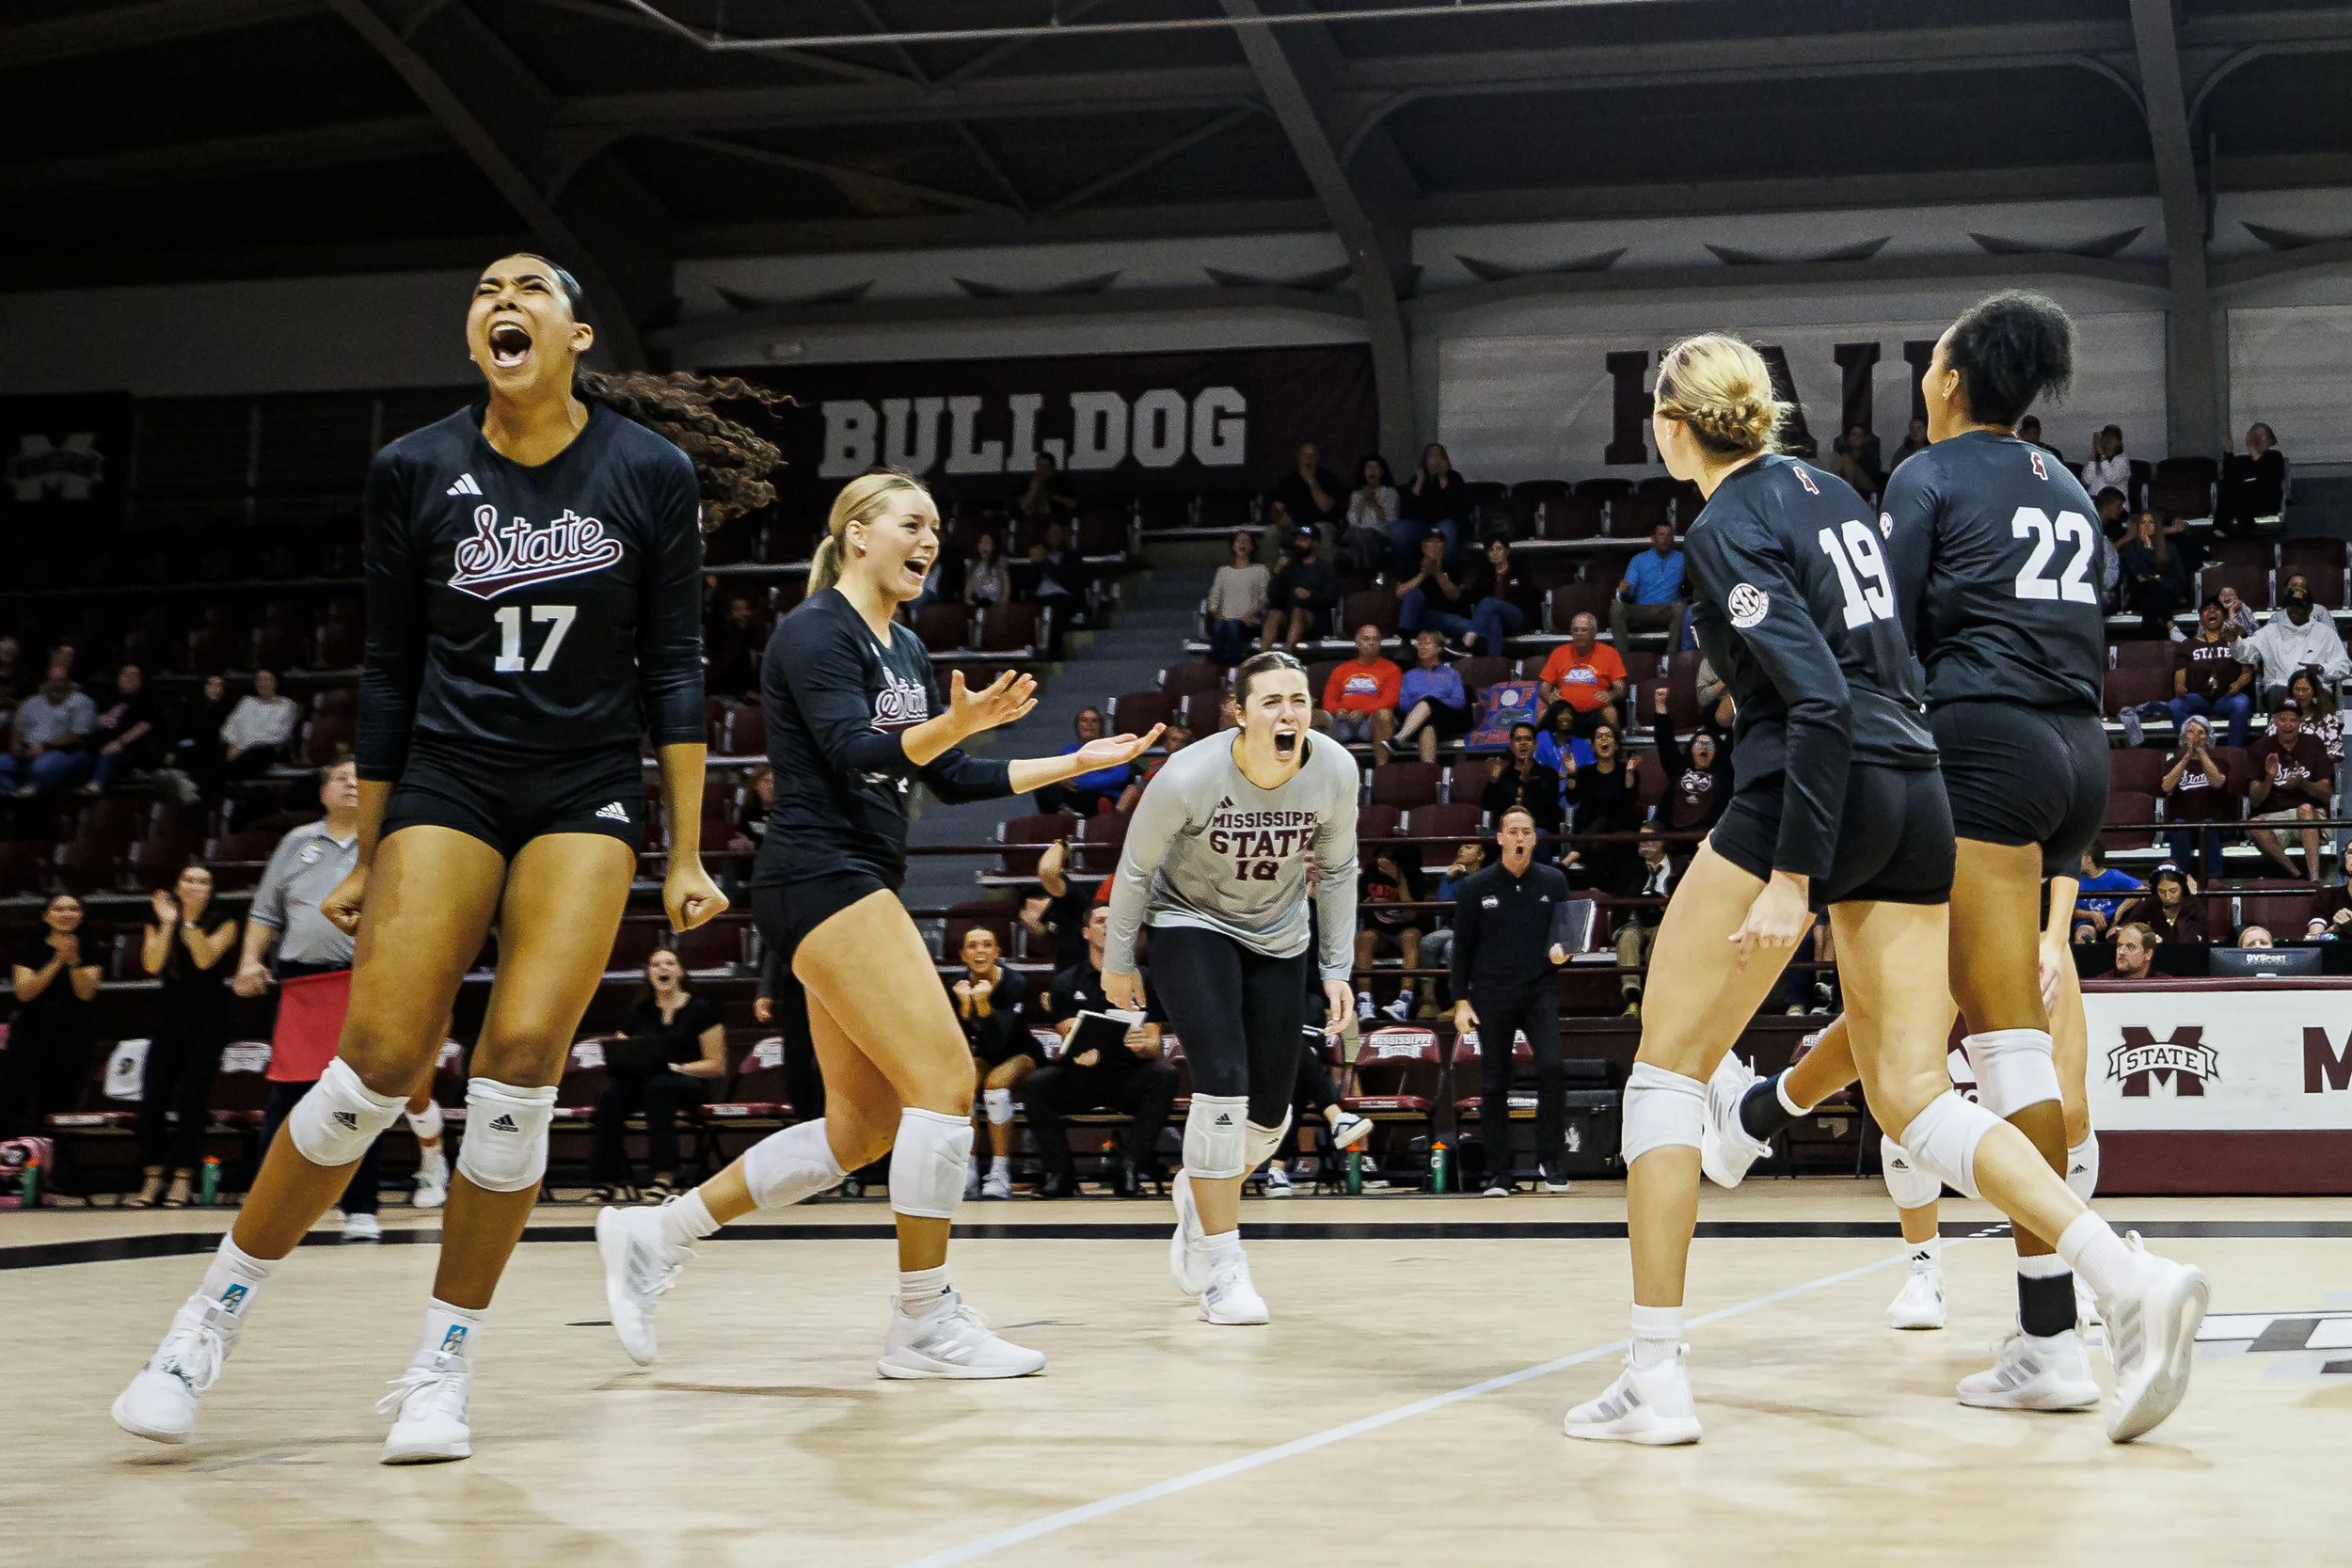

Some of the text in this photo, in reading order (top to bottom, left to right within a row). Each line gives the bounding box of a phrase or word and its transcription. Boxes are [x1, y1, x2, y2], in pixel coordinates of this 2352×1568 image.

[818, 386, 1247, 478] BULLDOG
[450, 504, 623, 578] State
[1819, 519, 1894, 630] 19
[2011, 507, 2097, 605] 22
[1731, 587, 1759, 617] SEC
[494, 605, 577, 672] 17
[1209, 828, 1315, 858] STATE
[1212, 811, 1317, 828] MISSISSIPP
[2126, 1048, 2198, 1070] STATE
